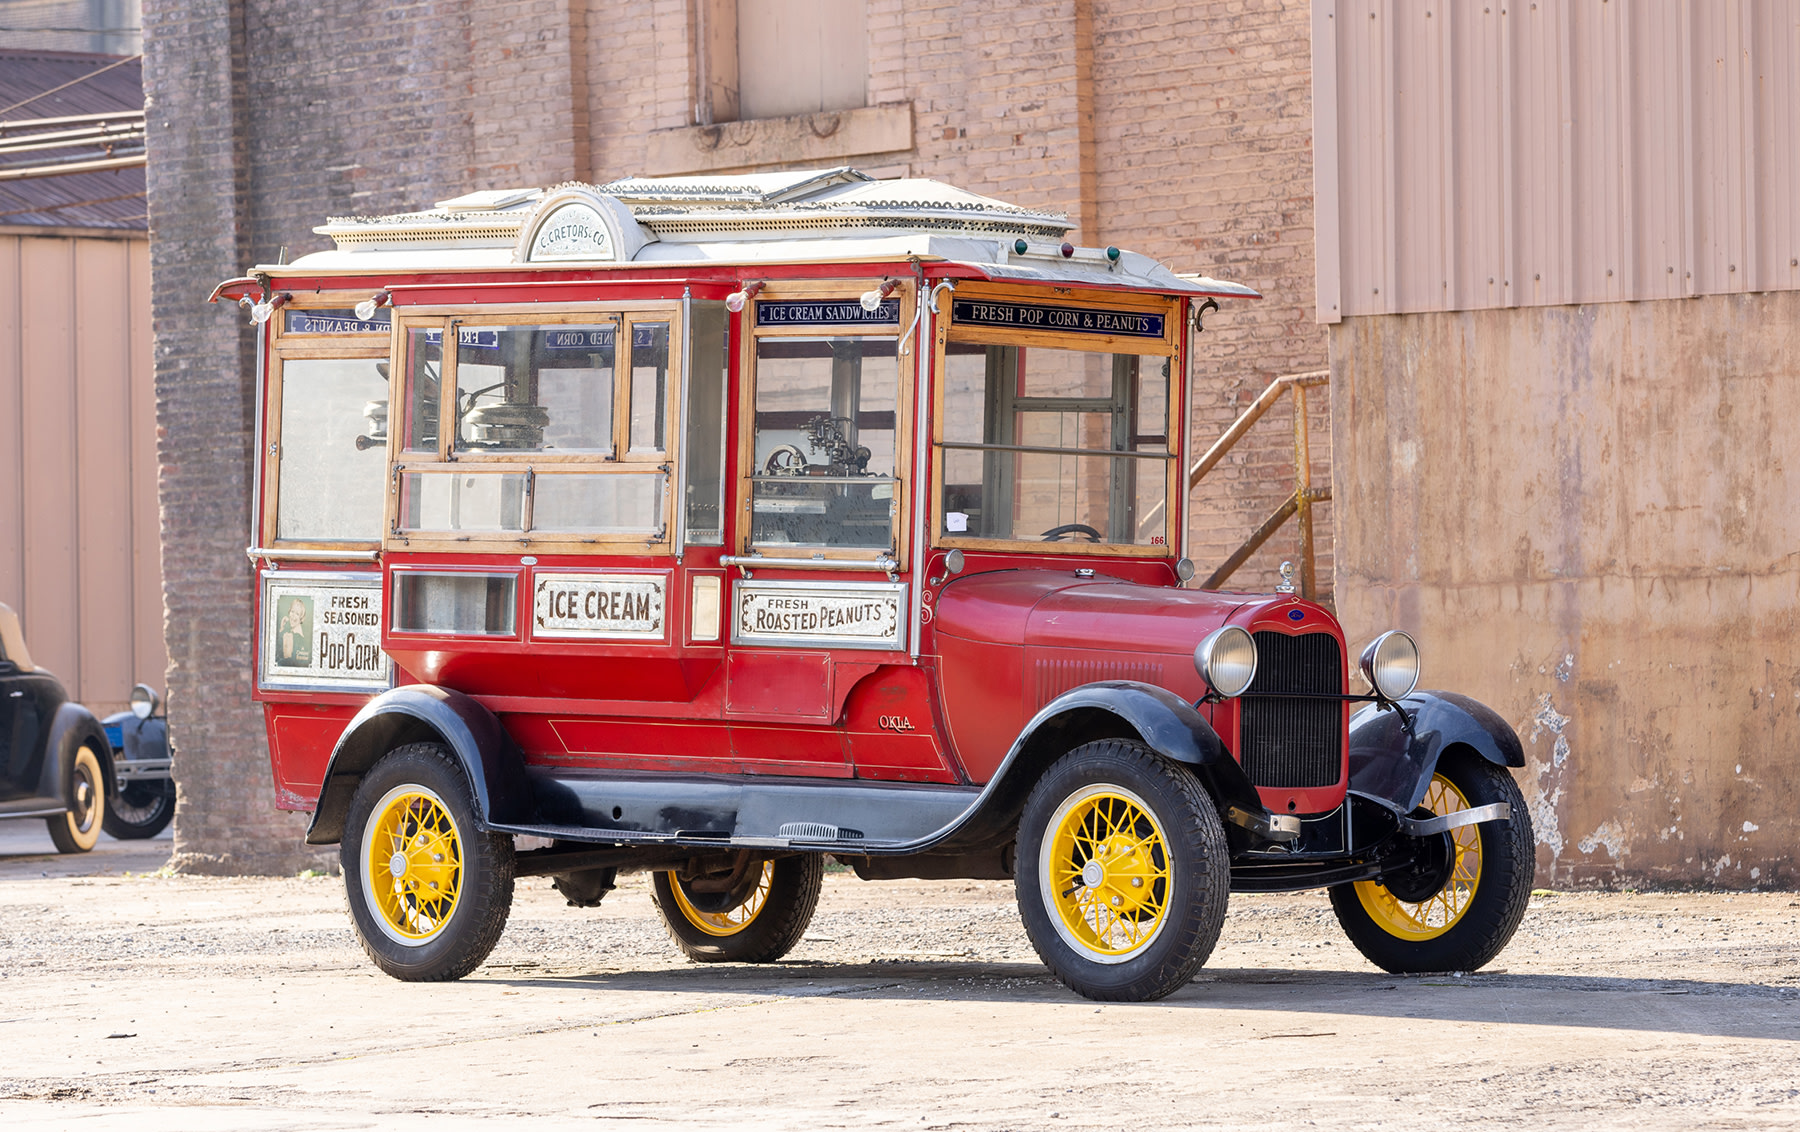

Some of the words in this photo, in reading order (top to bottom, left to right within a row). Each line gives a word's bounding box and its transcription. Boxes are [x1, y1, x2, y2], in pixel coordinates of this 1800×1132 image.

[769, 307, 786, 320] ICE
[789, 306, 823, 320] CREAM
[826, 305, 890, 320] SANDWICHES
[971, 305, 1013, 322] FRESH
[1019, 308, 1044, 324] POP
[1049, 311, 1079, 327] CORN
[1083, 313, 1093, 328] &
[1097, 314, 1149, 332] PEANUTS
[1151, 536, 1164, 545] 166
[331, 596, 369, 609] FRESH
[549, 590, 579, 619] ICE
[584, 591, 650, 621] CREAM
[767, 599, 809, 609] FRESH
[323, 611, 379, 626] SEASONED
[756, 608, 817, 631] ROASTED
[819, 603, 882, 629] PEANUTS
